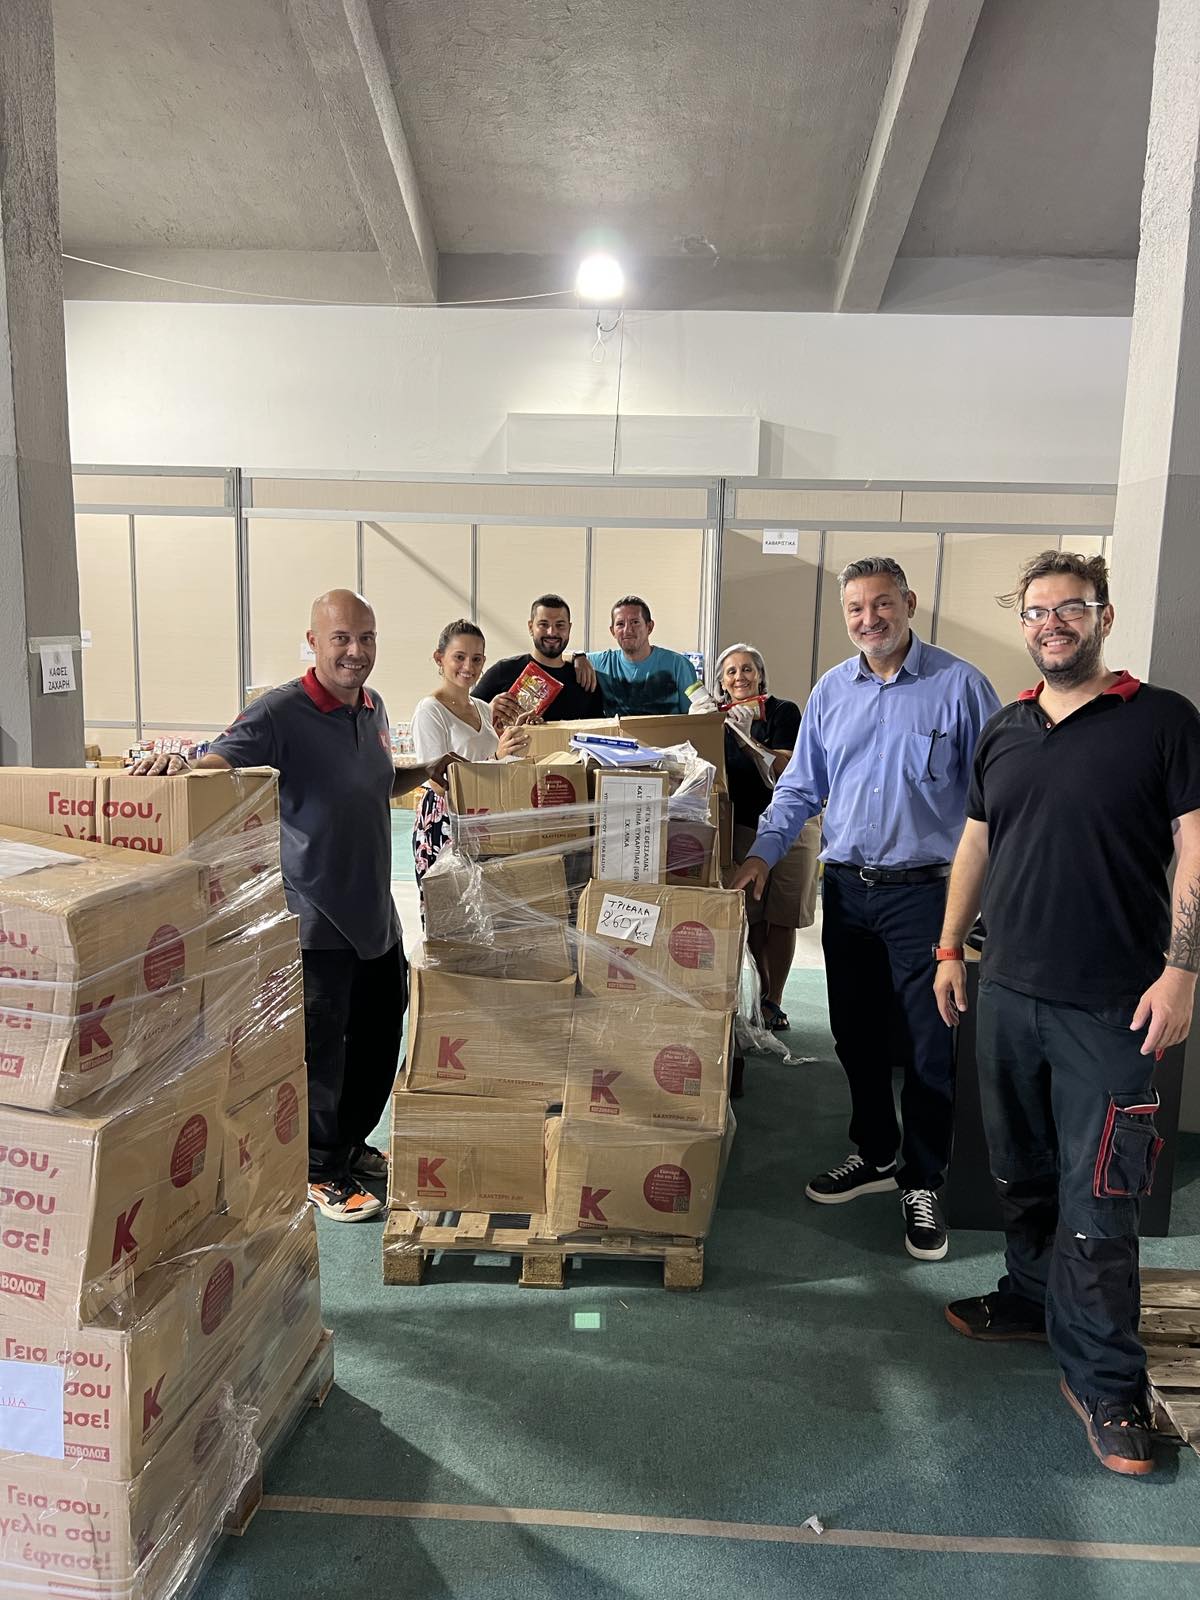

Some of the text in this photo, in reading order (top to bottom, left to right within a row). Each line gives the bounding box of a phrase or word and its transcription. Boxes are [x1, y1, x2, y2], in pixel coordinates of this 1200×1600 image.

[48, 680, 70, 691] ΖΑΧΑΡΗ
[49, 666, 68, 677] ΚΑΦΕΣ
[48, 791, 162, 823] Γεια σου,
[601, 909, 632, 929] 260
[438, 1036, 468, 1070] Κ
[591, 1069, 622, 1104] Κ
[418, 1157, 447, 1188] Κ
[579, 1186, 611, 1221] Κ
[2, 1228, 51, 1256] σε!
[1, 1274, 42, 1297] ΒΟΛΟΣ
[5, 1338, 112, 1372] Γεια σου,
[64, 1381, 111, 1399] σου
[65, 1445, 107, 1460] ΣΟΒΟΛΟΣ
[7, 1485, 110, 1519] Γεια σου,
[65, 1528, 111, 1544] σου
[22, 1542, 111, 1571] έφτασε!
